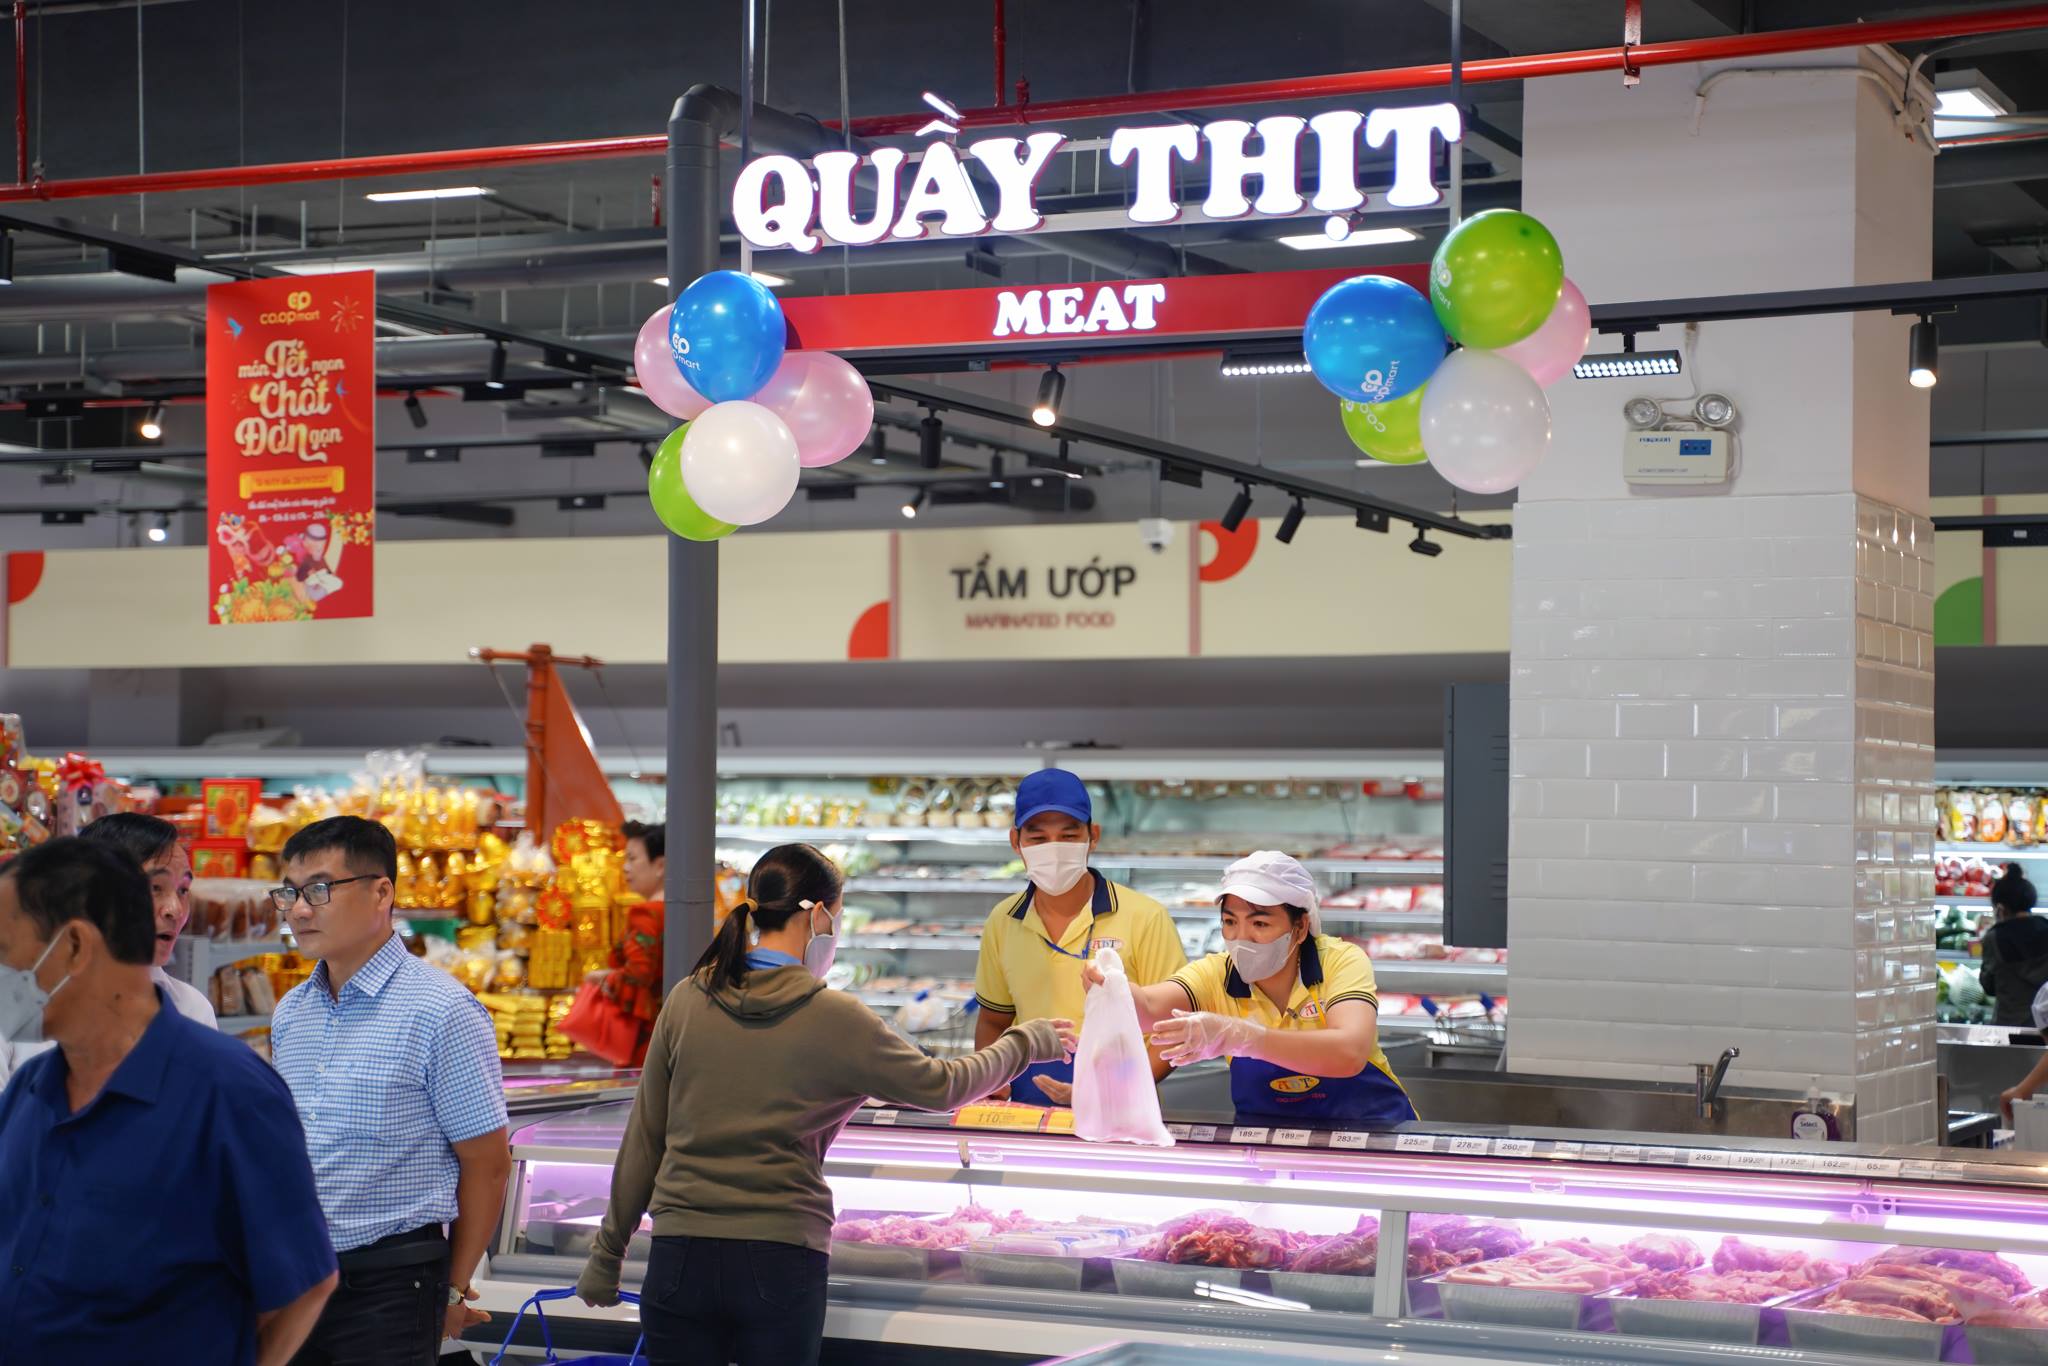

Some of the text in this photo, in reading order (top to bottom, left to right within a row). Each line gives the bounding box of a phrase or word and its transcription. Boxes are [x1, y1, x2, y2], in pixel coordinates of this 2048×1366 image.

[732, 91, 1463, 254] QUẦY THỊT
[993, 282, 1166, 336] MEAT
[264, 338, 309, 379] Tết
[250, 373, 332, 419] Chốt
[1047, 556, 1136, 598] ƯỚP
